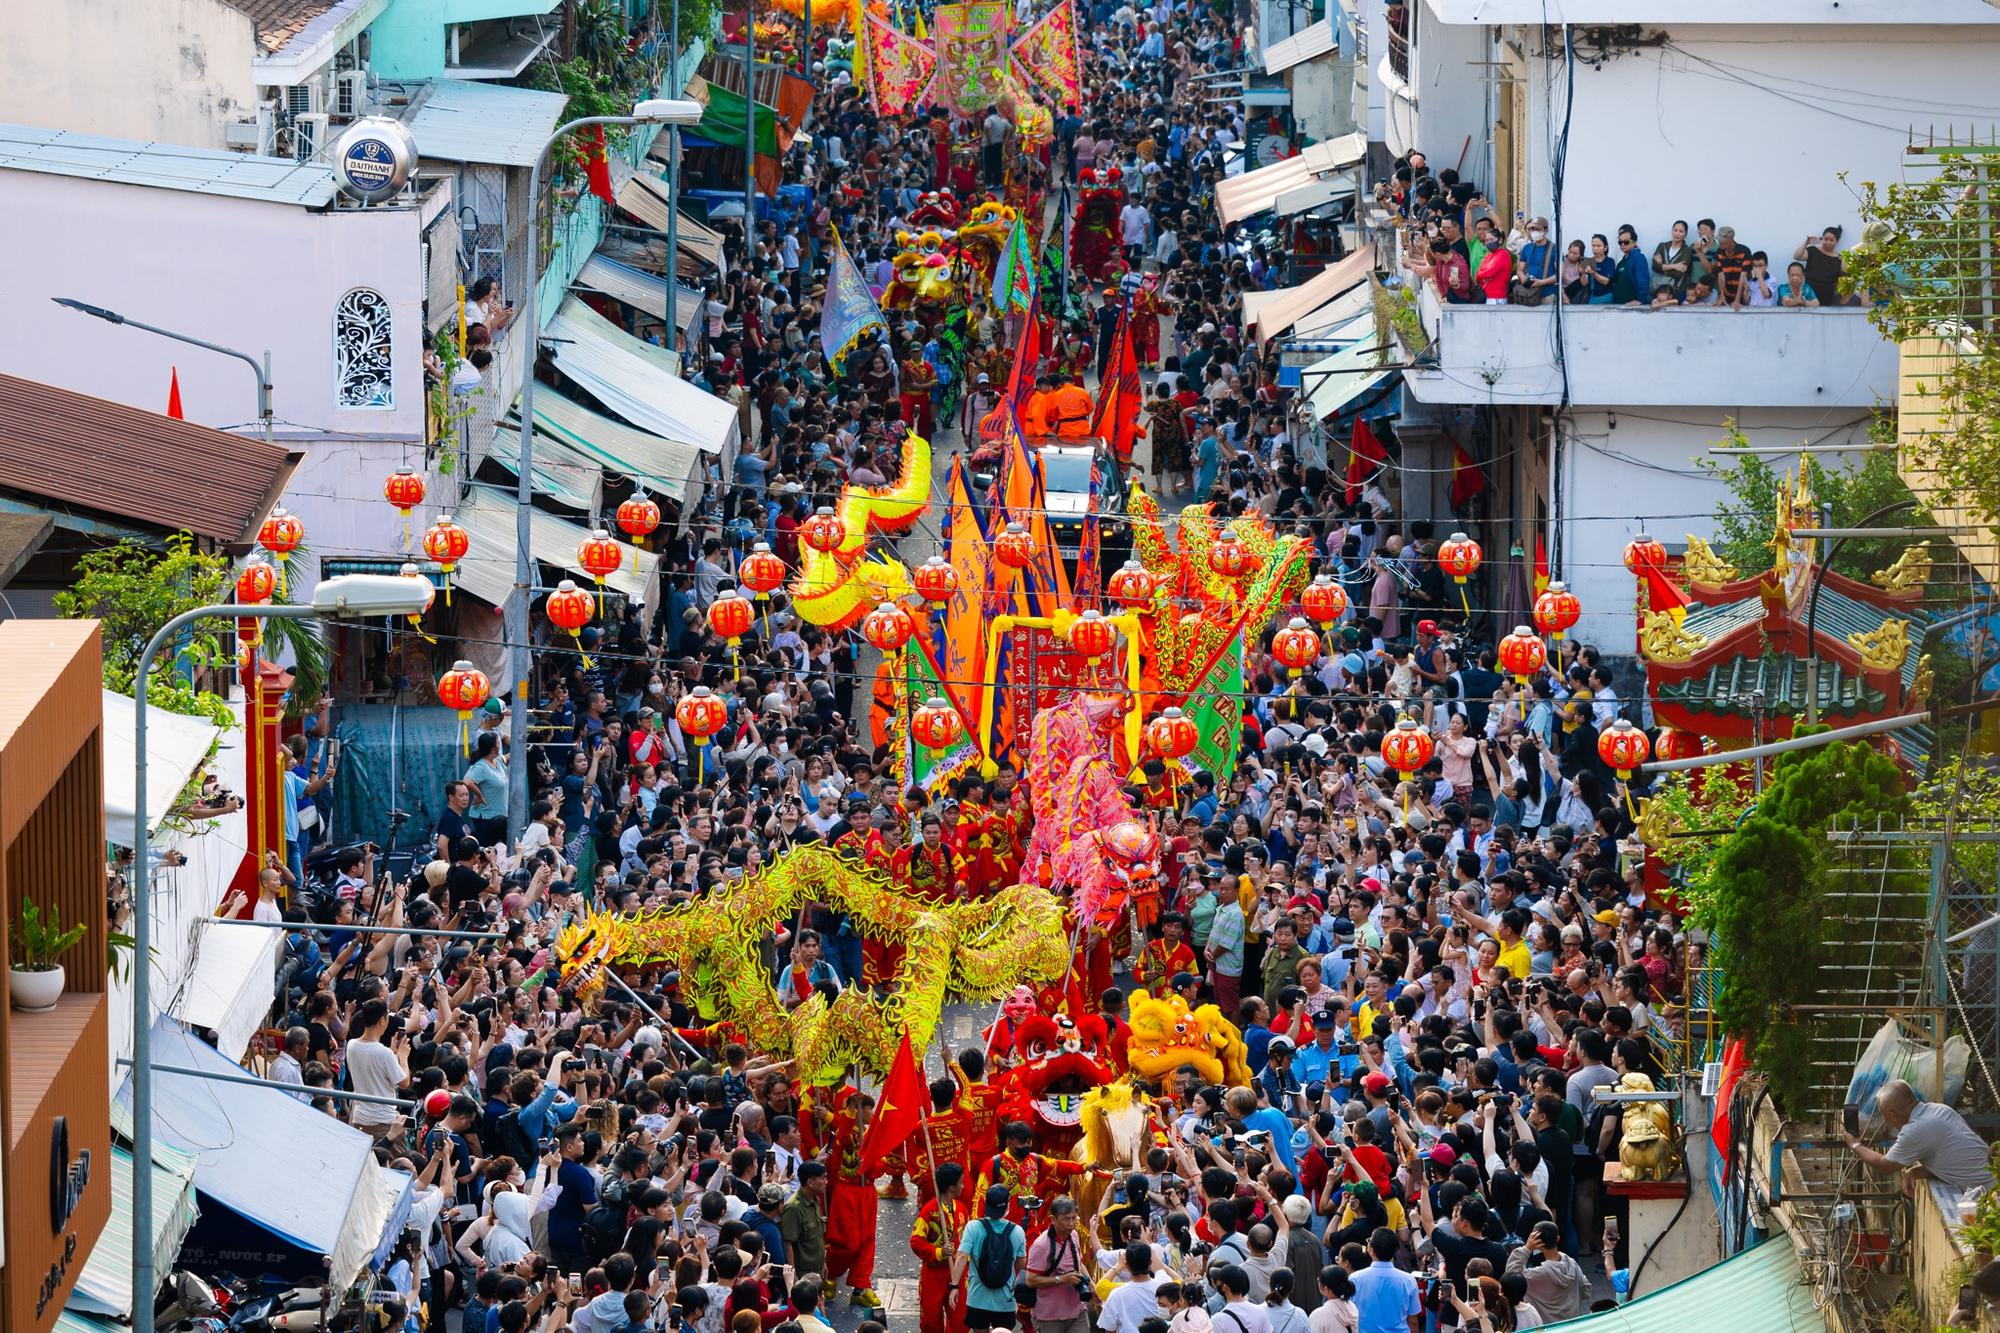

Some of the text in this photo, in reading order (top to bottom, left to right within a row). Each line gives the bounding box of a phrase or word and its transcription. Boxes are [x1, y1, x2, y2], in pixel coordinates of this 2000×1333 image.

[969, 23, 988, 32] ANH
[219, 1250, 263, 1262] NƯỚC
[266, 1252, 287, 1263] ÉP
